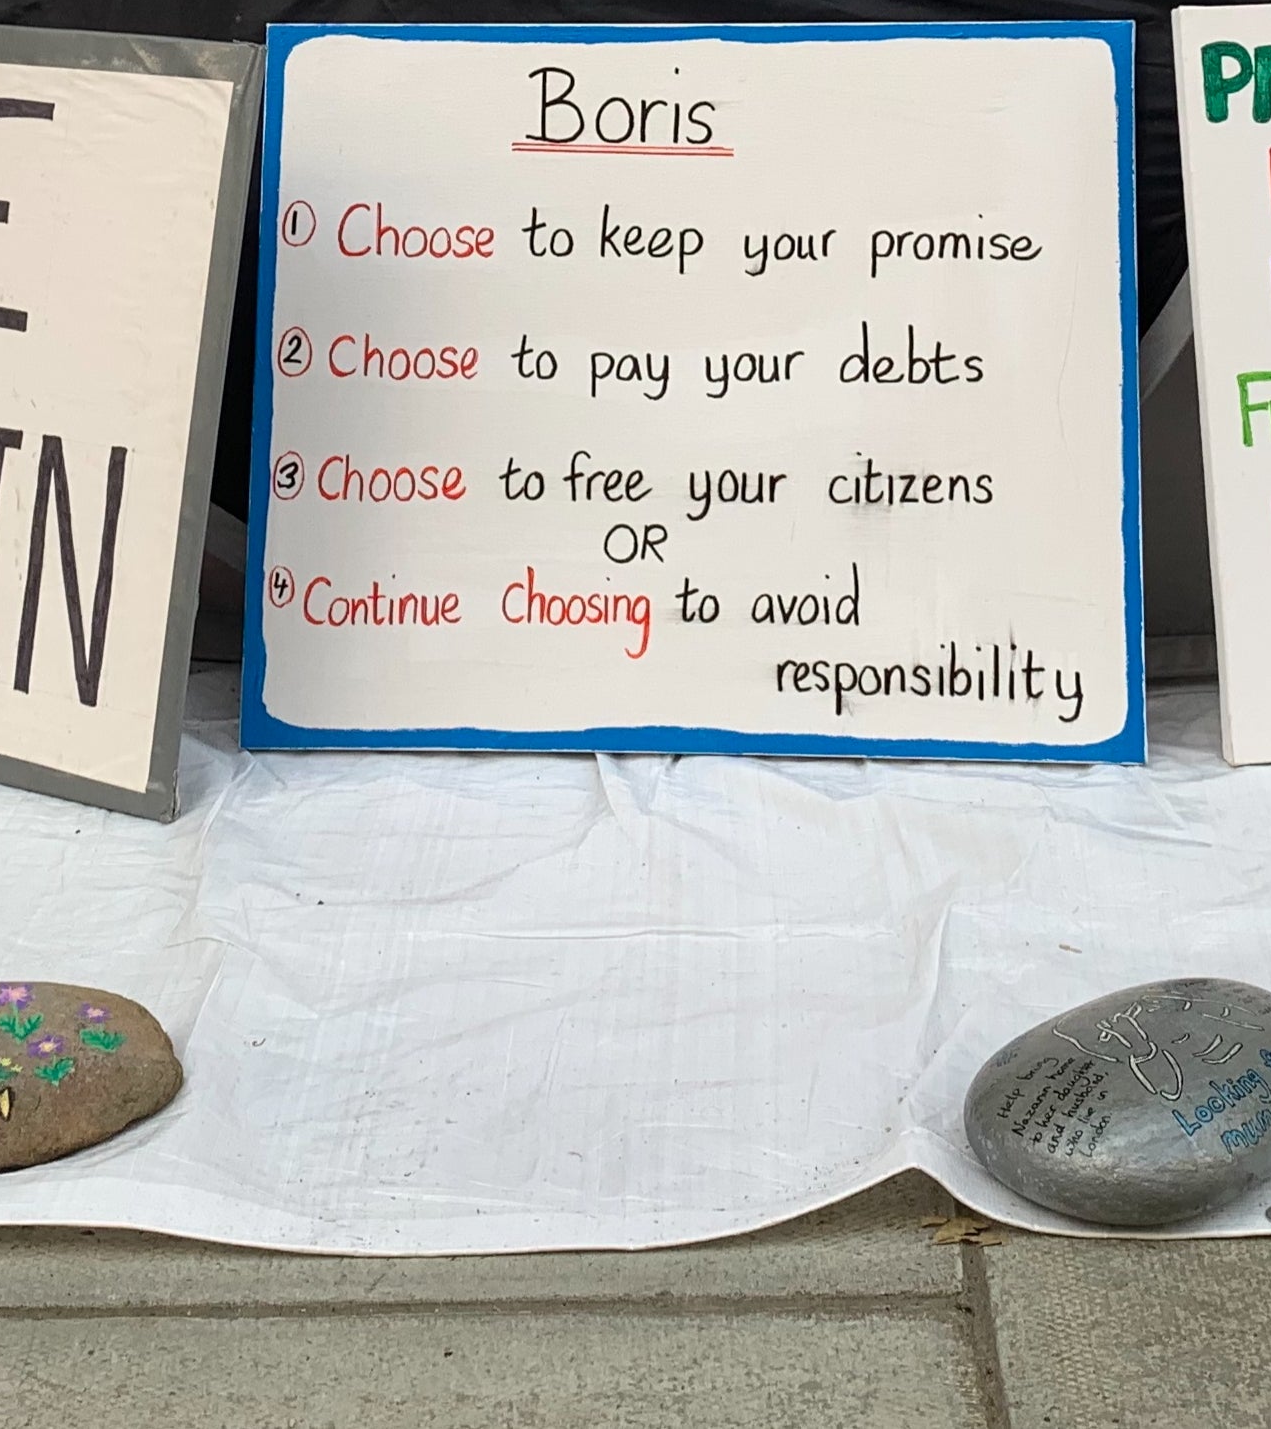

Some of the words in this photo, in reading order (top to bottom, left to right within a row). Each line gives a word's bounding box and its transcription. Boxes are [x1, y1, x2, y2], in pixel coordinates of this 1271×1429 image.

[526, 67, 715, 144] Boris
[338, 203, 494, 258] Choose
[522, 207, 574, 257] to
[601, 204, 703, 274] keep
[744, 230, 836, 277] your
[870, 215, 1043, 277] promise
[329, 333, 477, 380] Choose
[511, 334, 557, 379] to
[591, 352, 669, 401] pay
[706, 351, 804, 398] your
[840, 321, 983, 384] debts
[318, 454, 466, 502] Choose
[499, 457, 544, 500] to
[563, 451, 652, 502] free
[687, 470, 787, 521] your
[829, 452, 992, 506] citizens
[604, 524, 668, 564] OR
[304, 577, 460, 626] Continue
[501, 567, 650, 658] Choosing
[675, 577, 719, 623] to
[751, 562, 859, 626] avoid
[777, 638, 1083, 723] responsibility
[997, 1087, 1026, 1119] Help
[1016, 1056, 1060, 1082] bring
[1011, 1085, 1052, 1138] Nazanin
[1045, 1056, 1076, 1081] home
[1052, 1059, 1096, 1102] daughter
[1029, 1131, 1043, 1147] to
[1034, 1104, 1057, 1129] her
[1047, 1122, 1066, 1155] and
[1065, 1128, 1084, 1158] who
